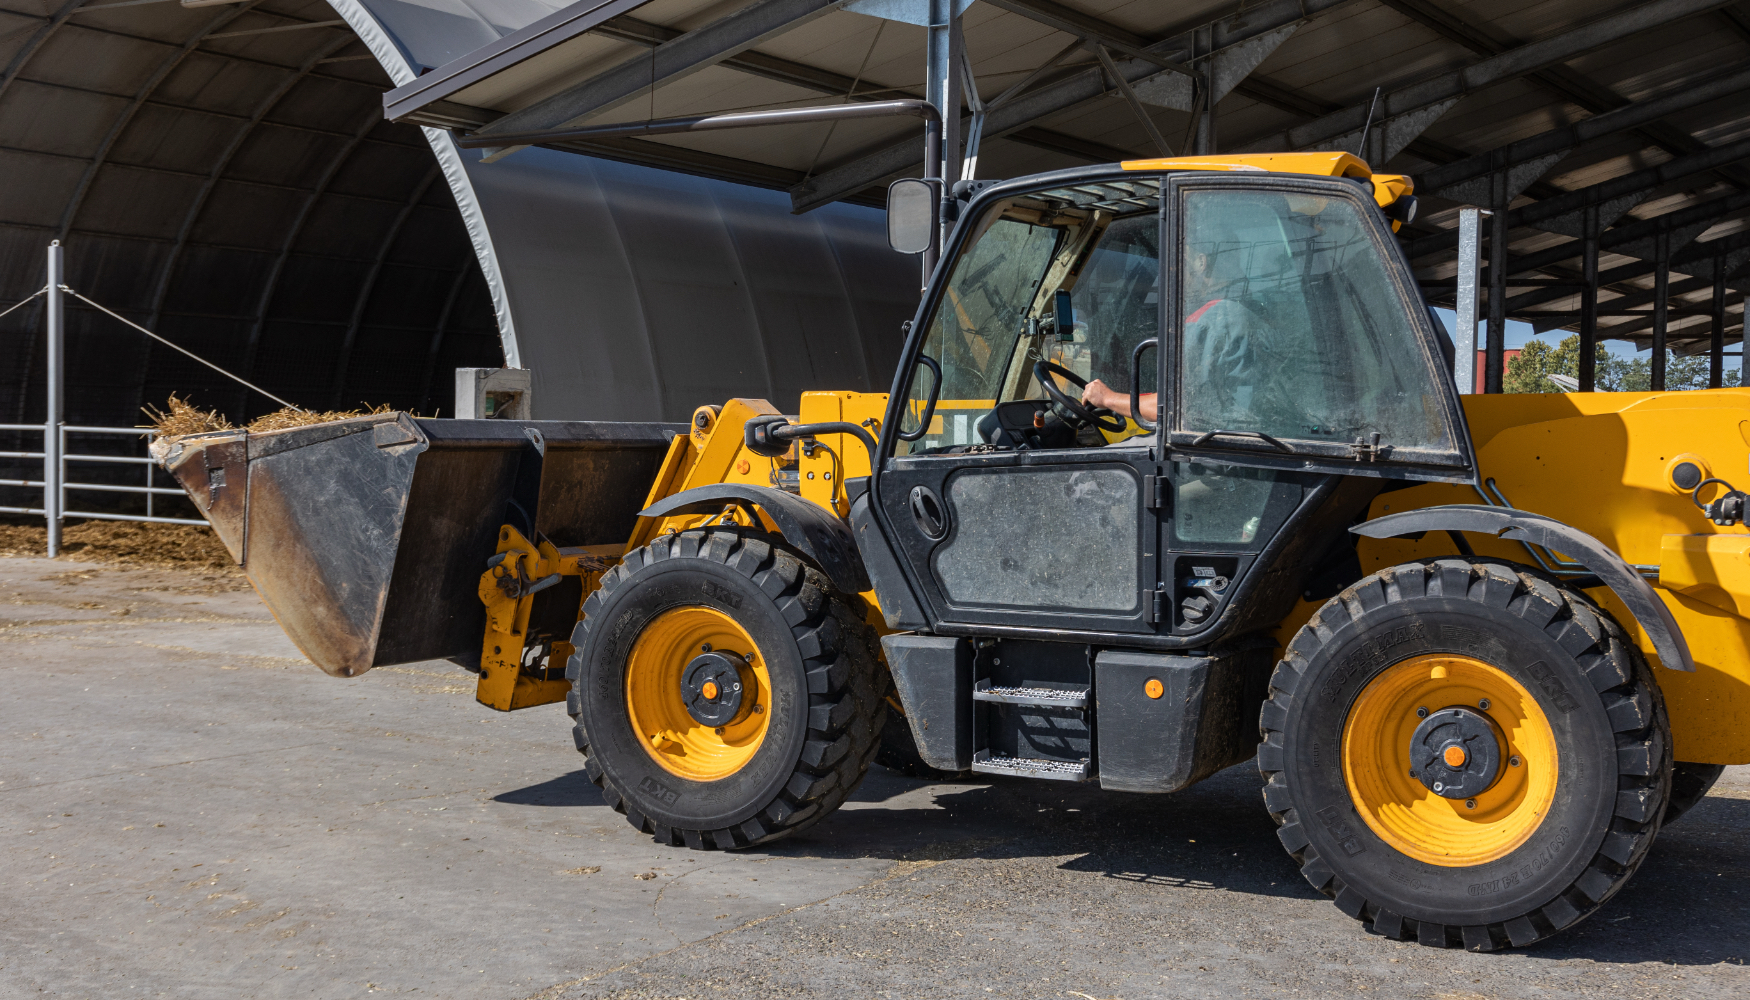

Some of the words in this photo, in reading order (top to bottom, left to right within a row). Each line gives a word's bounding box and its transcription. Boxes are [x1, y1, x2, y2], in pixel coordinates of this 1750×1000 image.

[1320, 622, 1425, 703] MULTIMAX
[1529, 662, 1575, 712] BKT
[640, 776, 679, 805] BKT
[1319, 808, 1363, 856] BKT
[1532, 825, 1571, 872] 460/70
[1467, 879, 1500, 897] IND
[1502, 871, 1521, 889] 24
[1520, 864, 1534, 879] R
